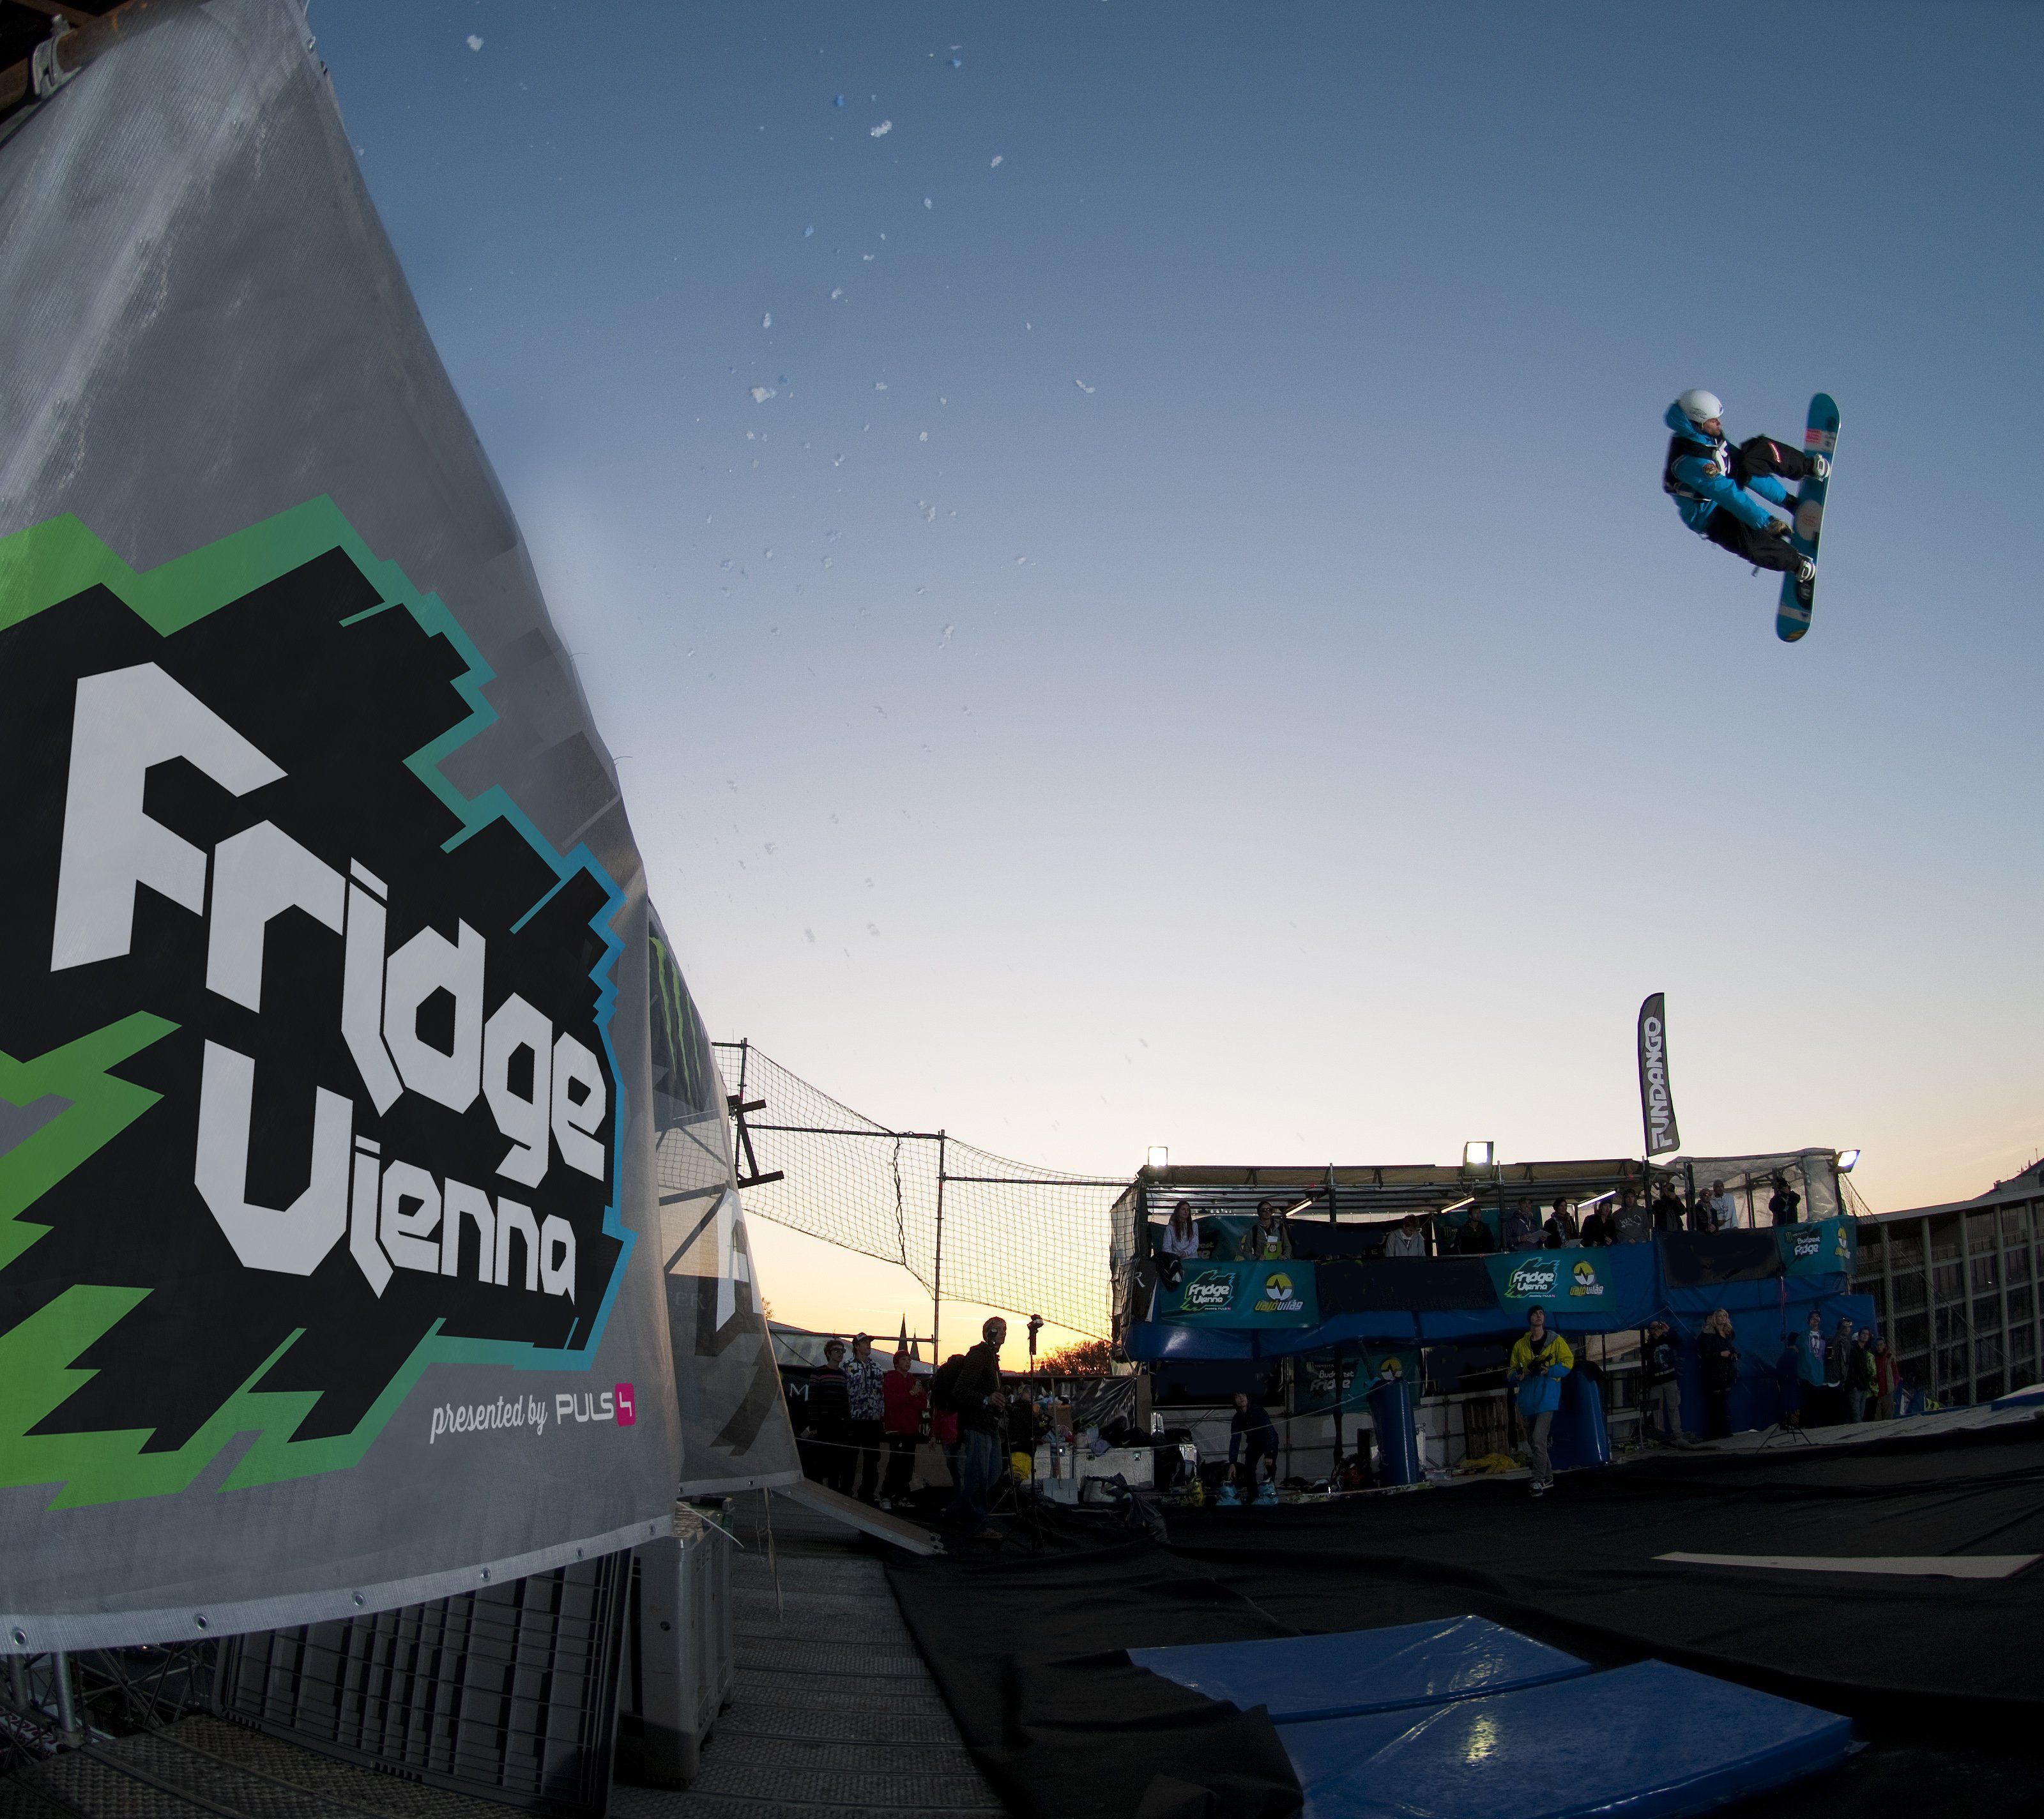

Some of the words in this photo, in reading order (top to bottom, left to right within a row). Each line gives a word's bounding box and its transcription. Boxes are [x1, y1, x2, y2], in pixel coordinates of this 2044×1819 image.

[51, 661, 607, 1190] Fridge
[1644, 1016, 1673, 1150] FUNDANGO
[1513, 1272, 1555, 1284] Fridge
[1188, 1284, 1231, 1296] Fridge
[1318, 1369, 1355, 1378] Budest
[1309, 1378, 1352, 1392] Fride
[429, 1395, 526, 1444] presented
[528, 1395, 548, 1436] by
